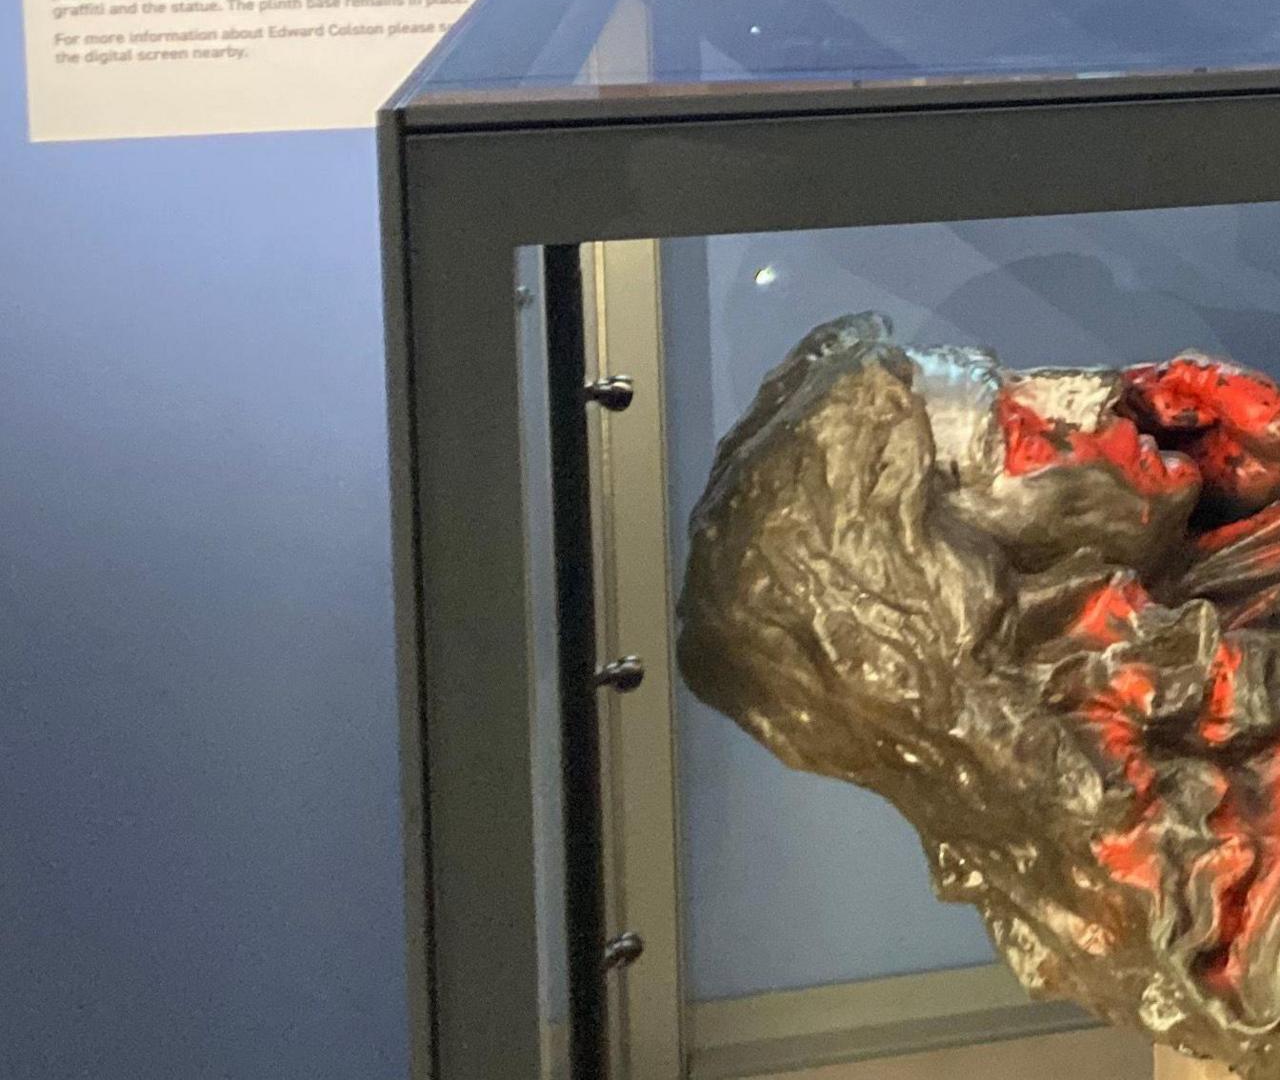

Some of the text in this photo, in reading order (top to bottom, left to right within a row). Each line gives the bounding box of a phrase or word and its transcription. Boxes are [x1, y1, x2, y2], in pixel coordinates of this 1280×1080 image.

[53, 3, 105, 19] graffiti
[109, 2, 137, 15] and
[142, 2, 166, 14] the
[171, 1, 223, 12] statue.
[226, 0, 254, 11] The
[54, 33, 80, 46] For
[84, 34, 124, 45] more
[129, 29, 218, 43] information
[222, 27, 264, 41] about
[268, 25, 325, 39] Edward
[328, 24, 384, 37] Colston
[388, 22, 435, 37] please
[55, 46, 248, 65] the digital screen nearby.
